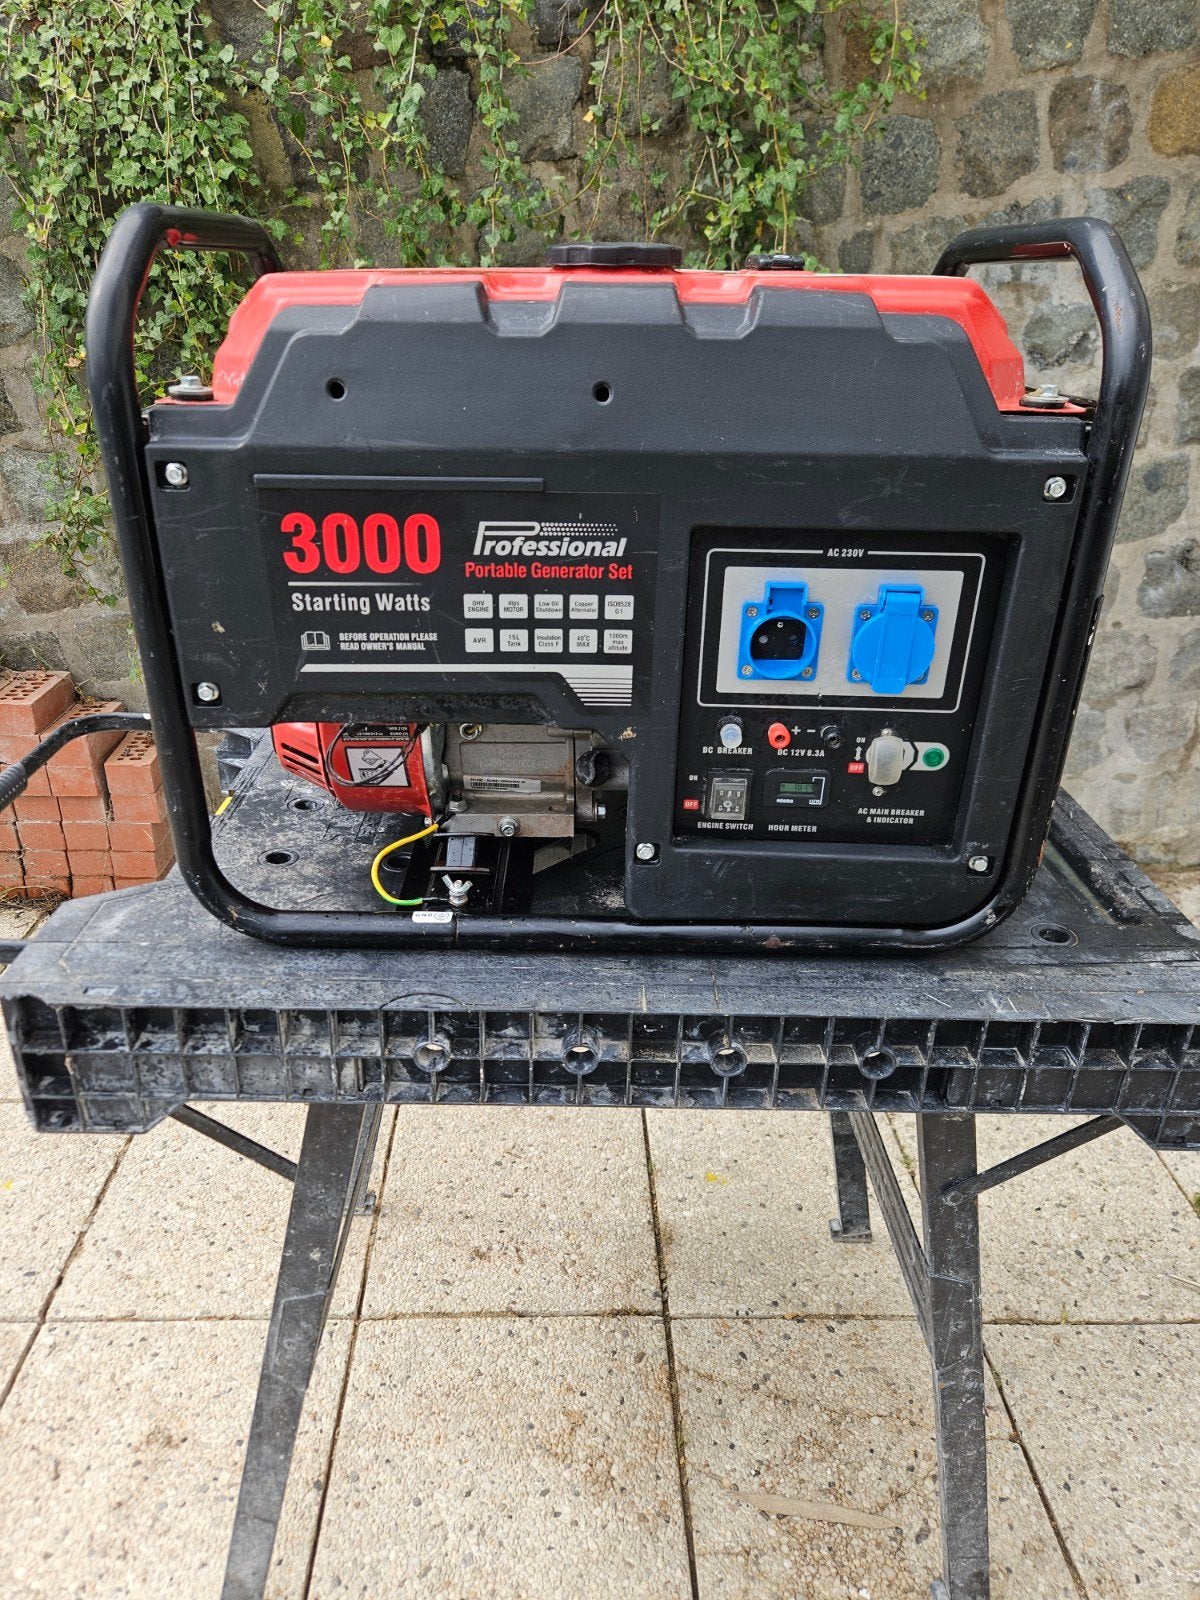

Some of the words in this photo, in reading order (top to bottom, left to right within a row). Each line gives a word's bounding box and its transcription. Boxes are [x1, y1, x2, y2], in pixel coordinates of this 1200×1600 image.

[281, 512, 441, 574] 3000
[473, 521, 628, 557] Professional
[826, 548, 840, 557] AC
[842, 549, 864, 558] 230V
[465, 562, 526, 578] Portable
[531, 562, 604, 579] Generator
[608, 563, 633, 579] Set
[292, 593, 370, 615] Starting
[375, 593, 431, 612] Watts
[339, 632, 368, 641] BEFORE
[370, 633, 410, 641] OPERATION
[411, 633, 438, 641] PLEASE
[340, 642, 359, 650] READ
[361, 642, 394, 650] OWNER'S
[396, 642, 426, 650] MANUAL
[702, 746, 714, 754] DC
[717, 746, 753, 755] BREAKER
[791, 749, 805, 757] 12V
[807, 749, 825, 757] 8.3A
[890, 809, 925, 817] BREAKER
[697, 822, 724, 830] ENGINE
[725, 822, 754, 830] SWITCH
[768, 824, 790, 832] HOUR
